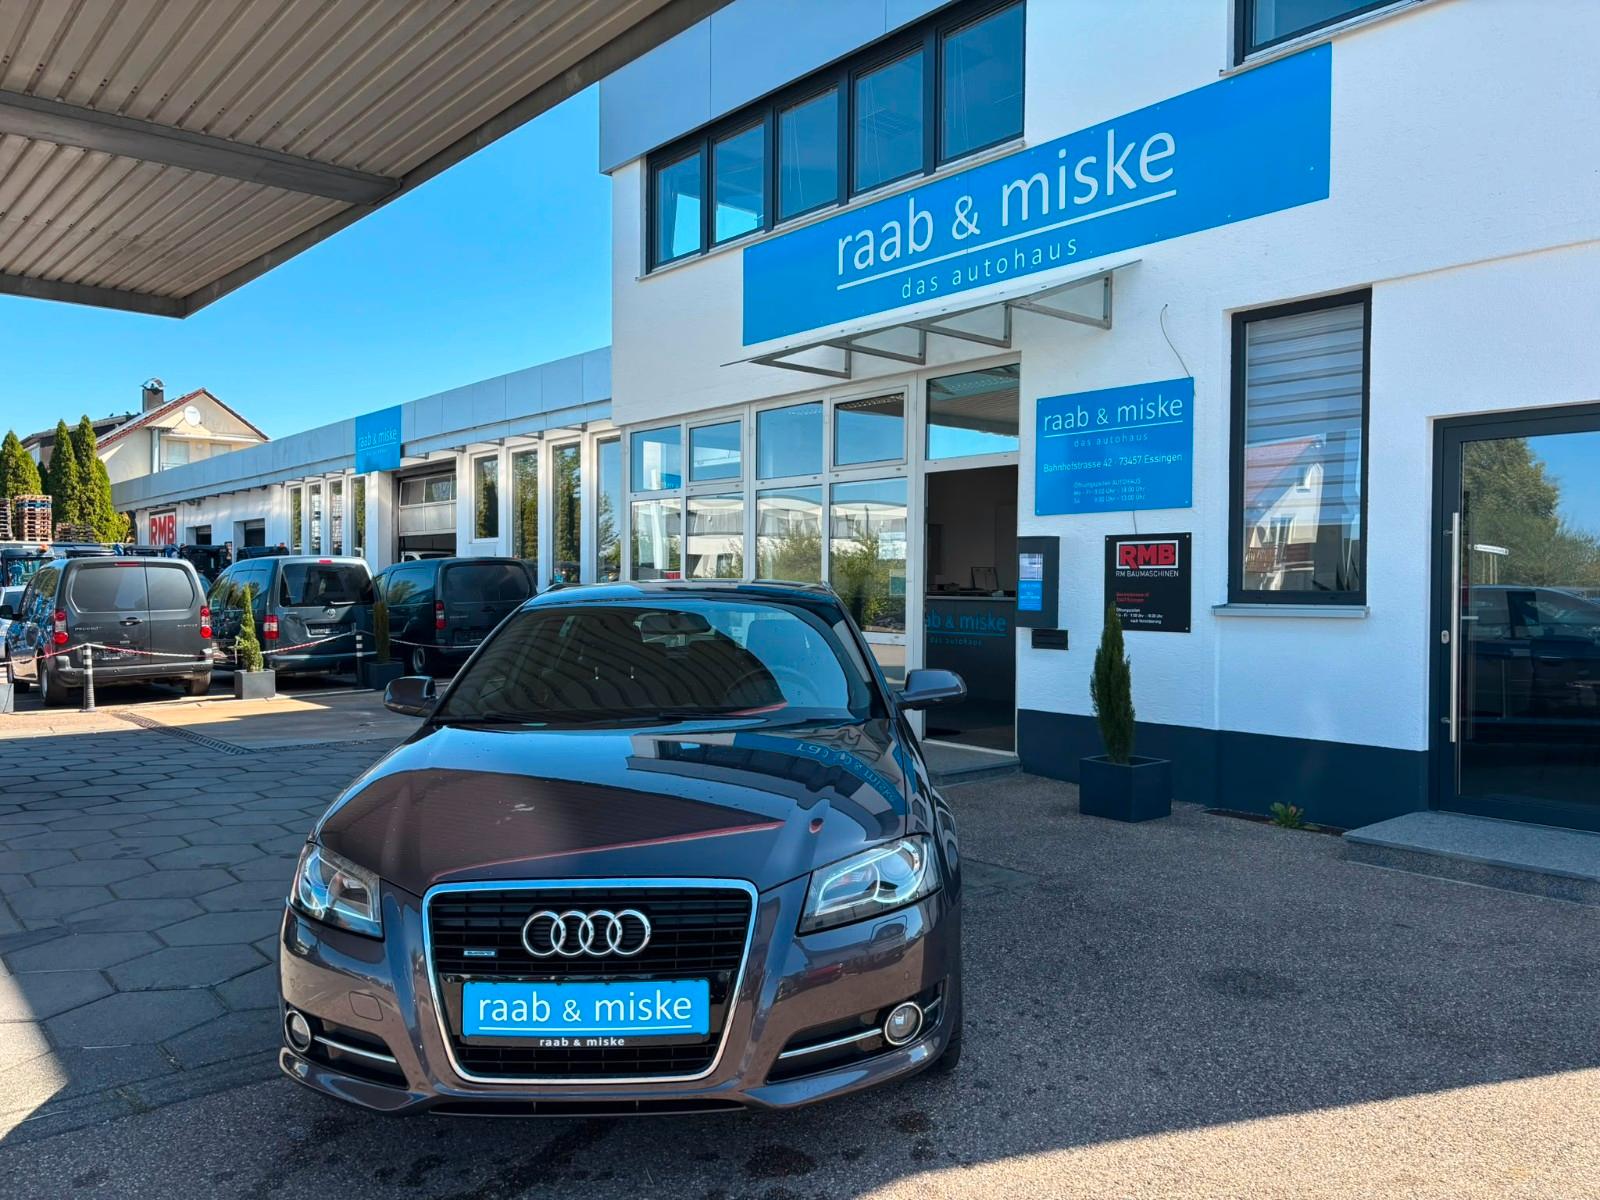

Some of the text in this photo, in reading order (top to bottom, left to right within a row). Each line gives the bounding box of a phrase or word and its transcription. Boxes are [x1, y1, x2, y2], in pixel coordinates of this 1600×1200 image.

[838, 129, 1176, 276] raab & miske
[902, 239, 1077, 299] das autohaus
[1044, 394, 1183, 432] raab & miske
[1074, 432, 1149, 448] das autohaus
[1044, 453, 1183, 473] Bahnhofstrasse 42 73457 Essingen
[151, 515, 175, 545] RMB
[1120, 544, 1175, 569] RMB
[1127, 569, 1179, 578] BAUMASCHINEN
[959, 608, 1008, 631] miske
[478, 989, 692, 1022] raab & miske
[539, 1036, 625, 1047] raab & miske
